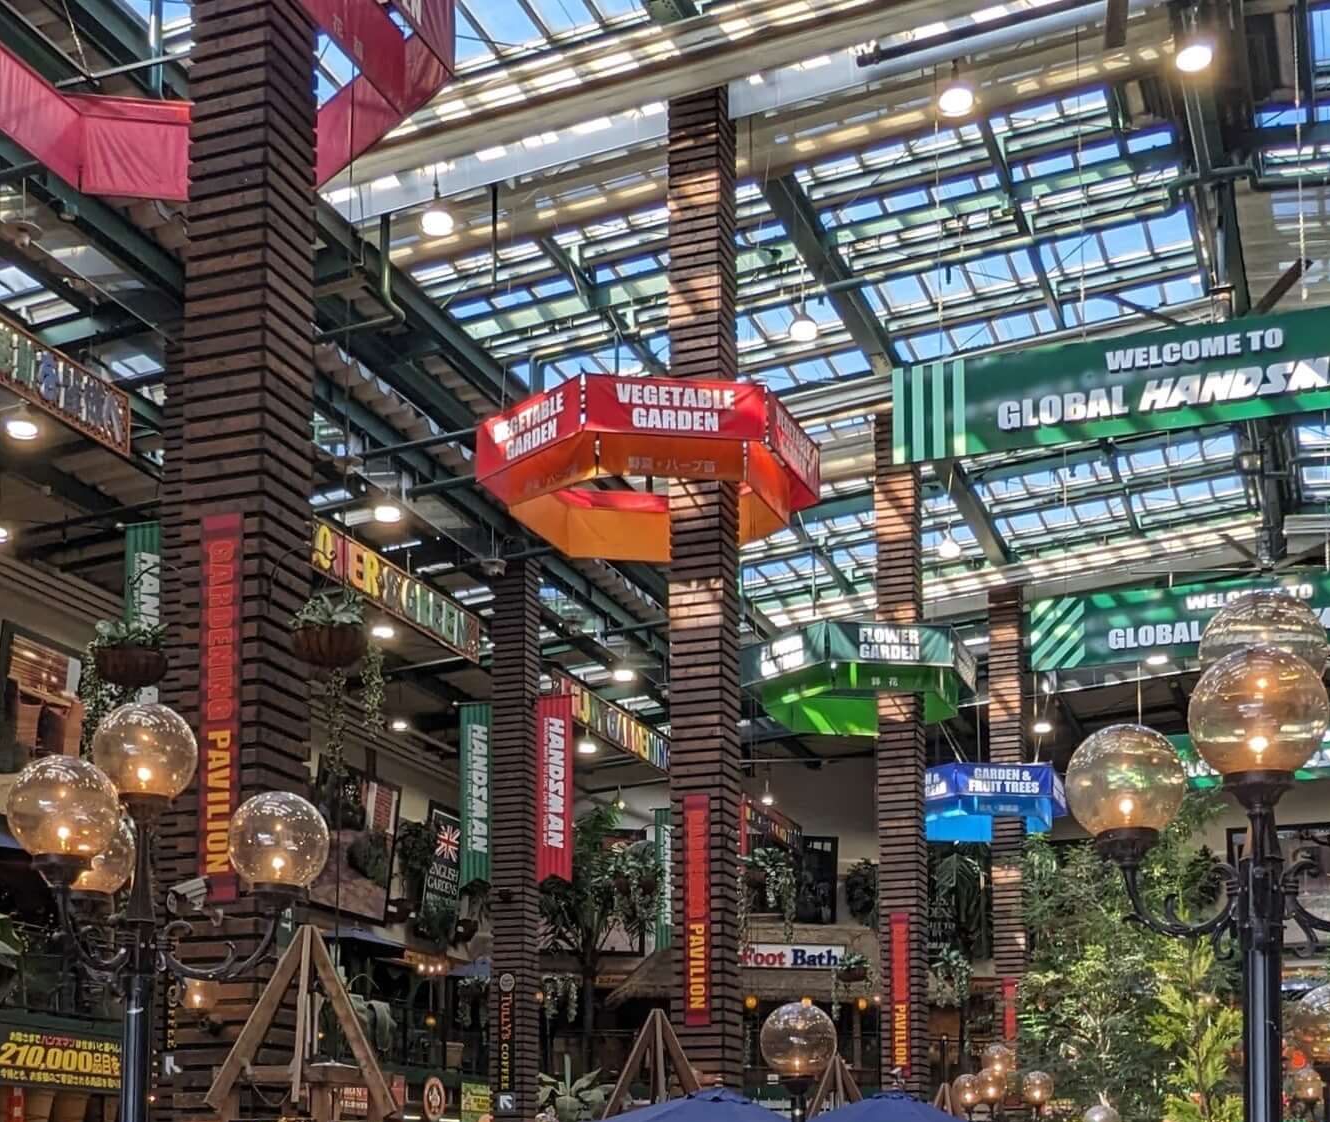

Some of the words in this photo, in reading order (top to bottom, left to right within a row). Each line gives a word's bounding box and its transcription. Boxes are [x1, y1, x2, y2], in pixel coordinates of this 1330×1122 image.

[1105, 333, 1242, 373] WELCOME
[1246, 327, 1284, 352] TO
[616, 382, 735, 410] VEGETABLE
[997, 387, 1129, 431] GLOBAL
[493, 391, 565, 443] VEGETABLE
[632, 407, 719, 432] GARDEN
[506, 418, 557, 460] GARDEN
[859, 627, 919, 643] FLOWER
[860, 645, 919, 660] GARDEN
[1108, 621, 1202, 650] GLOBAL
[472, 724, 488, 853] HANDSMAN
[548, 717, 565, 849] HANDSMAN
[968, 780, 1003, 793] FRUIT
[1005, 781, 1040, 794] TREES
[974, 768, 1014, 781] GARDEN
[1021, 770, 1031, 781] &
[206, 730, 231, 874] PAVILION
[429, 862, 459, 882] NGLISH
[689, 923, 706, 1009] PAVILION
[792, 949, 838, 966] Bath
[894, 1004, 907, 1065] PAVILION
